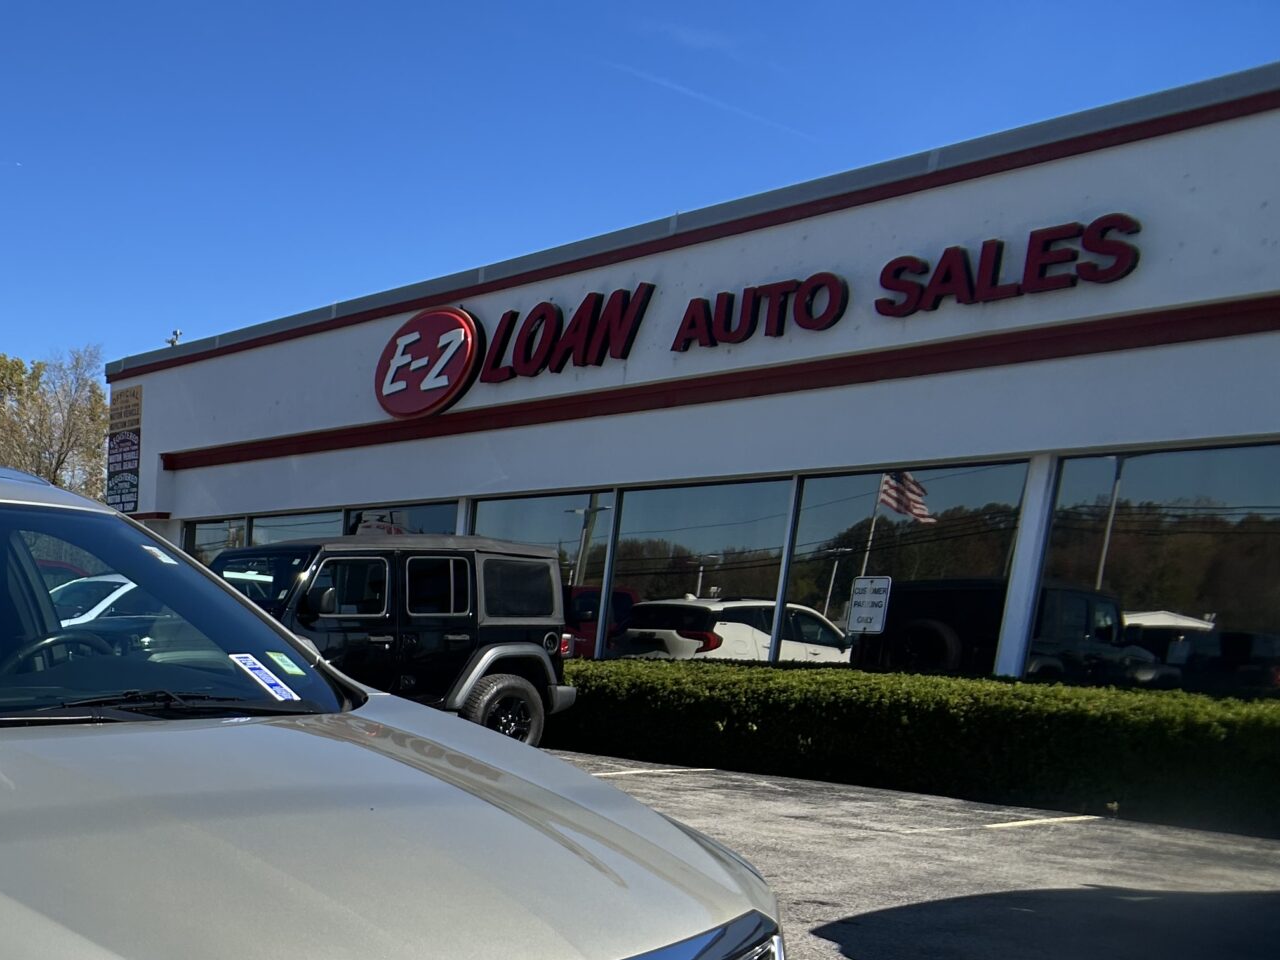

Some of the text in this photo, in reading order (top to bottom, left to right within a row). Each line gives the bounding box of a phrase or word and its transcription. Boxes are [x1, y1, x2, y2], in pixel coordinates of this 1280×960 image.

[382, 213, 1141, 397] E-Z LOAN AUTO SALES
[854, 587, 888, 595] CUSMER
[853, 600, 884, 608] PARING
